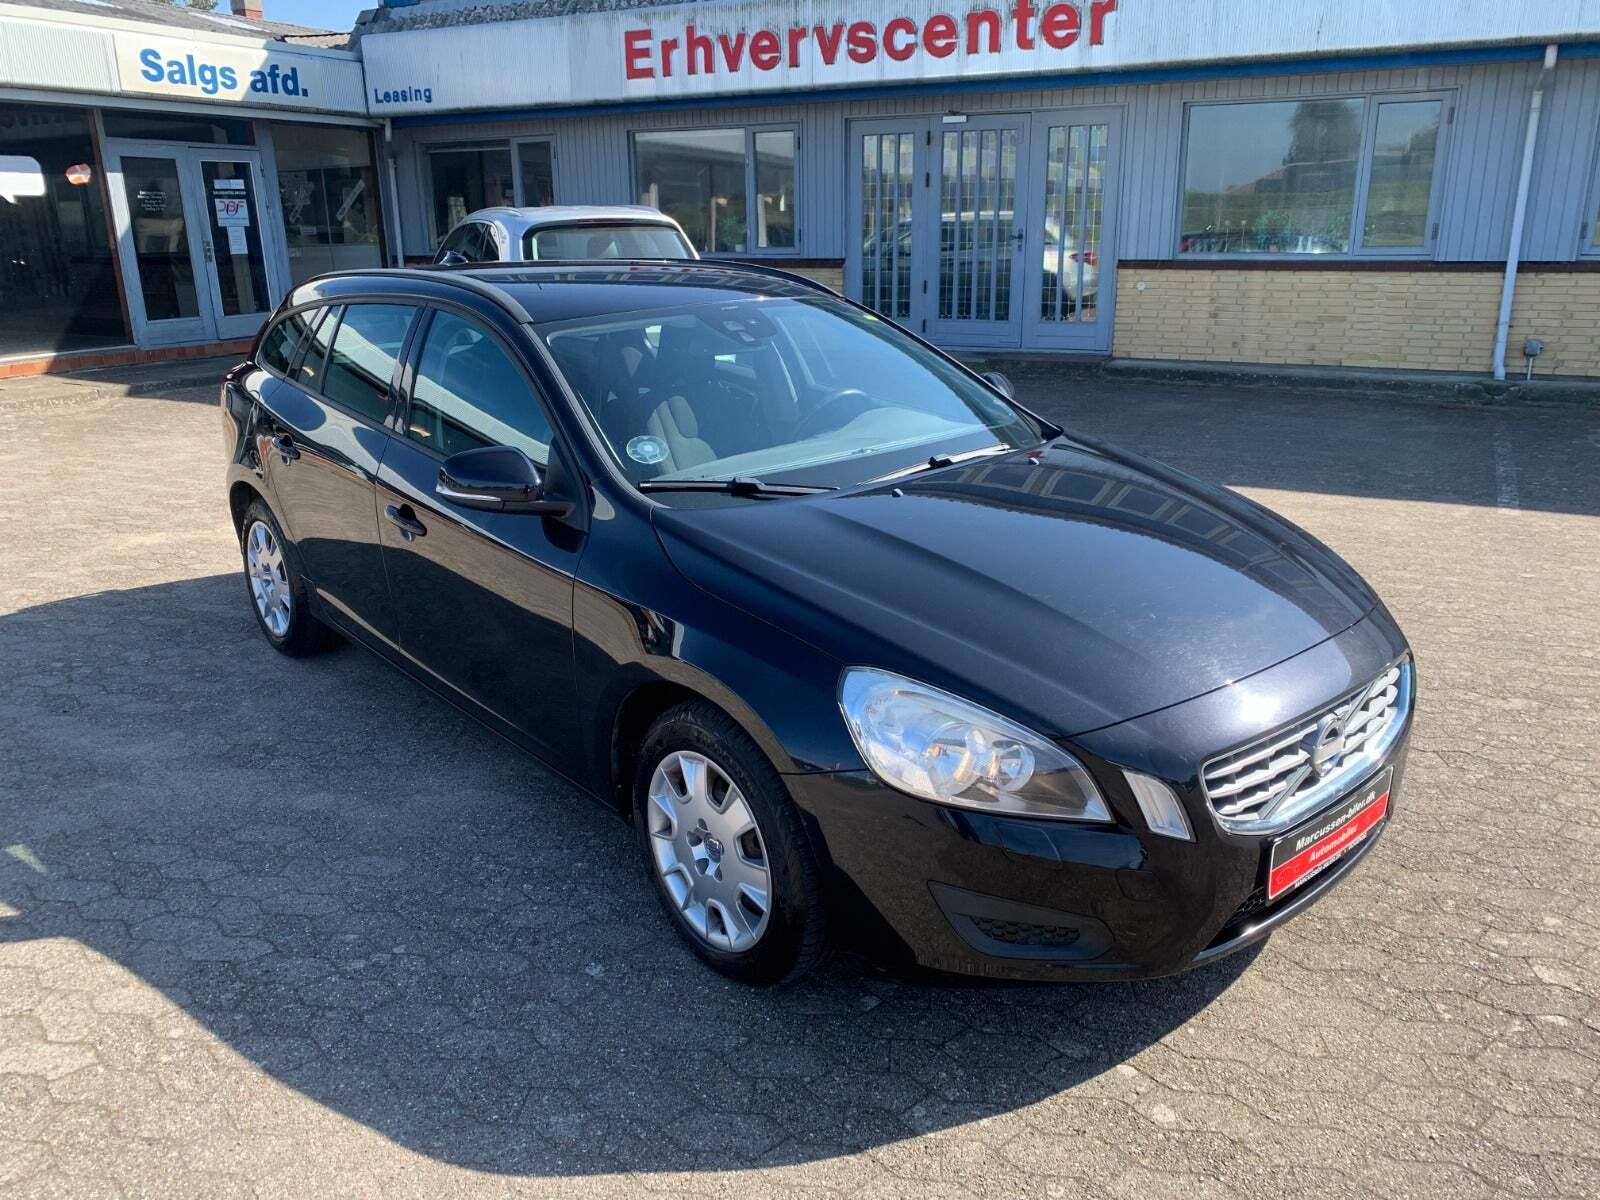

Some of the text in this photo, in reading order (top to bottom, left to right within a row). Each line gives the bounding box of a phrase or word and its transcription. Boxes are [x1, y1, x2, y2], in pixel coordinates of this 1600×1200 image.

[624, 0, 1117, 80] Erhvervscenter
[139, 48, 309, 97] Salgs afd.
[374, 86, 433, 104] Leasing
